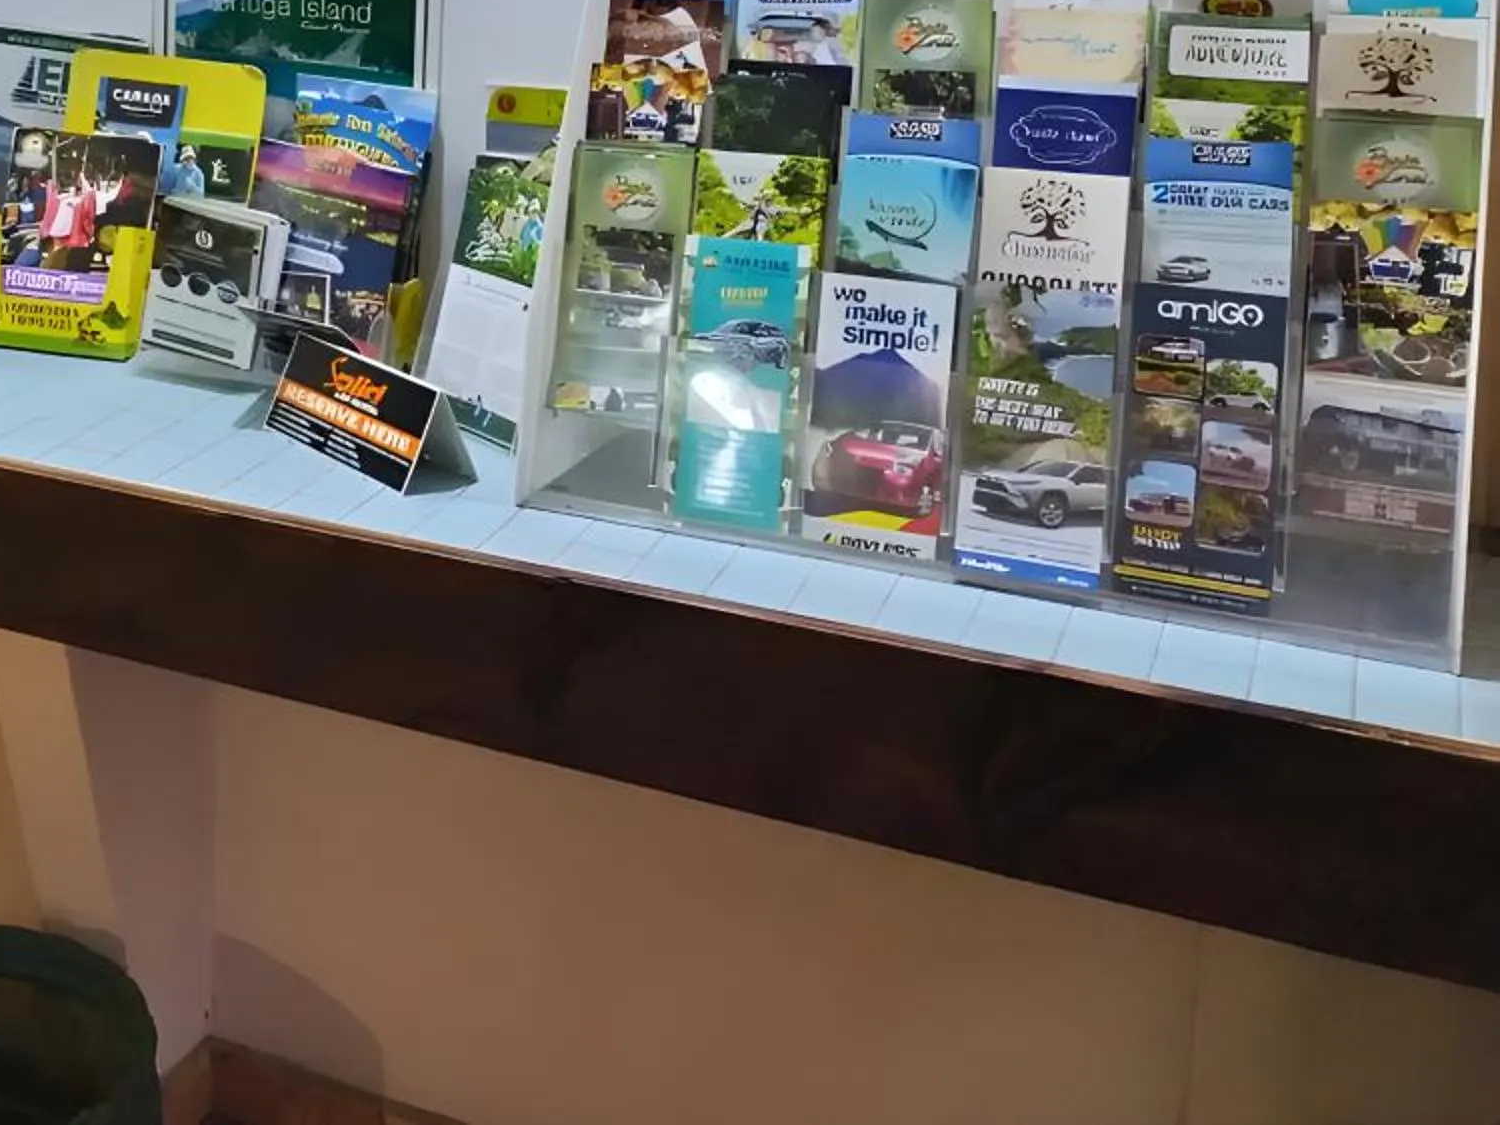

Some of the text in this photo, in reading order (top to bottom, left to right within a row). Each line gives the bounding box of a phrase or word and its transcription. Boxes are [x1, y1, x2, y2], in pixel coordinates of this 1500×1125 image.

[845, 303, 928, 328] make it
[842, 320, 940, 353] simple!
[285, 383, 358, 427] RESERVE
[362, 420, 411, 451] HERE
